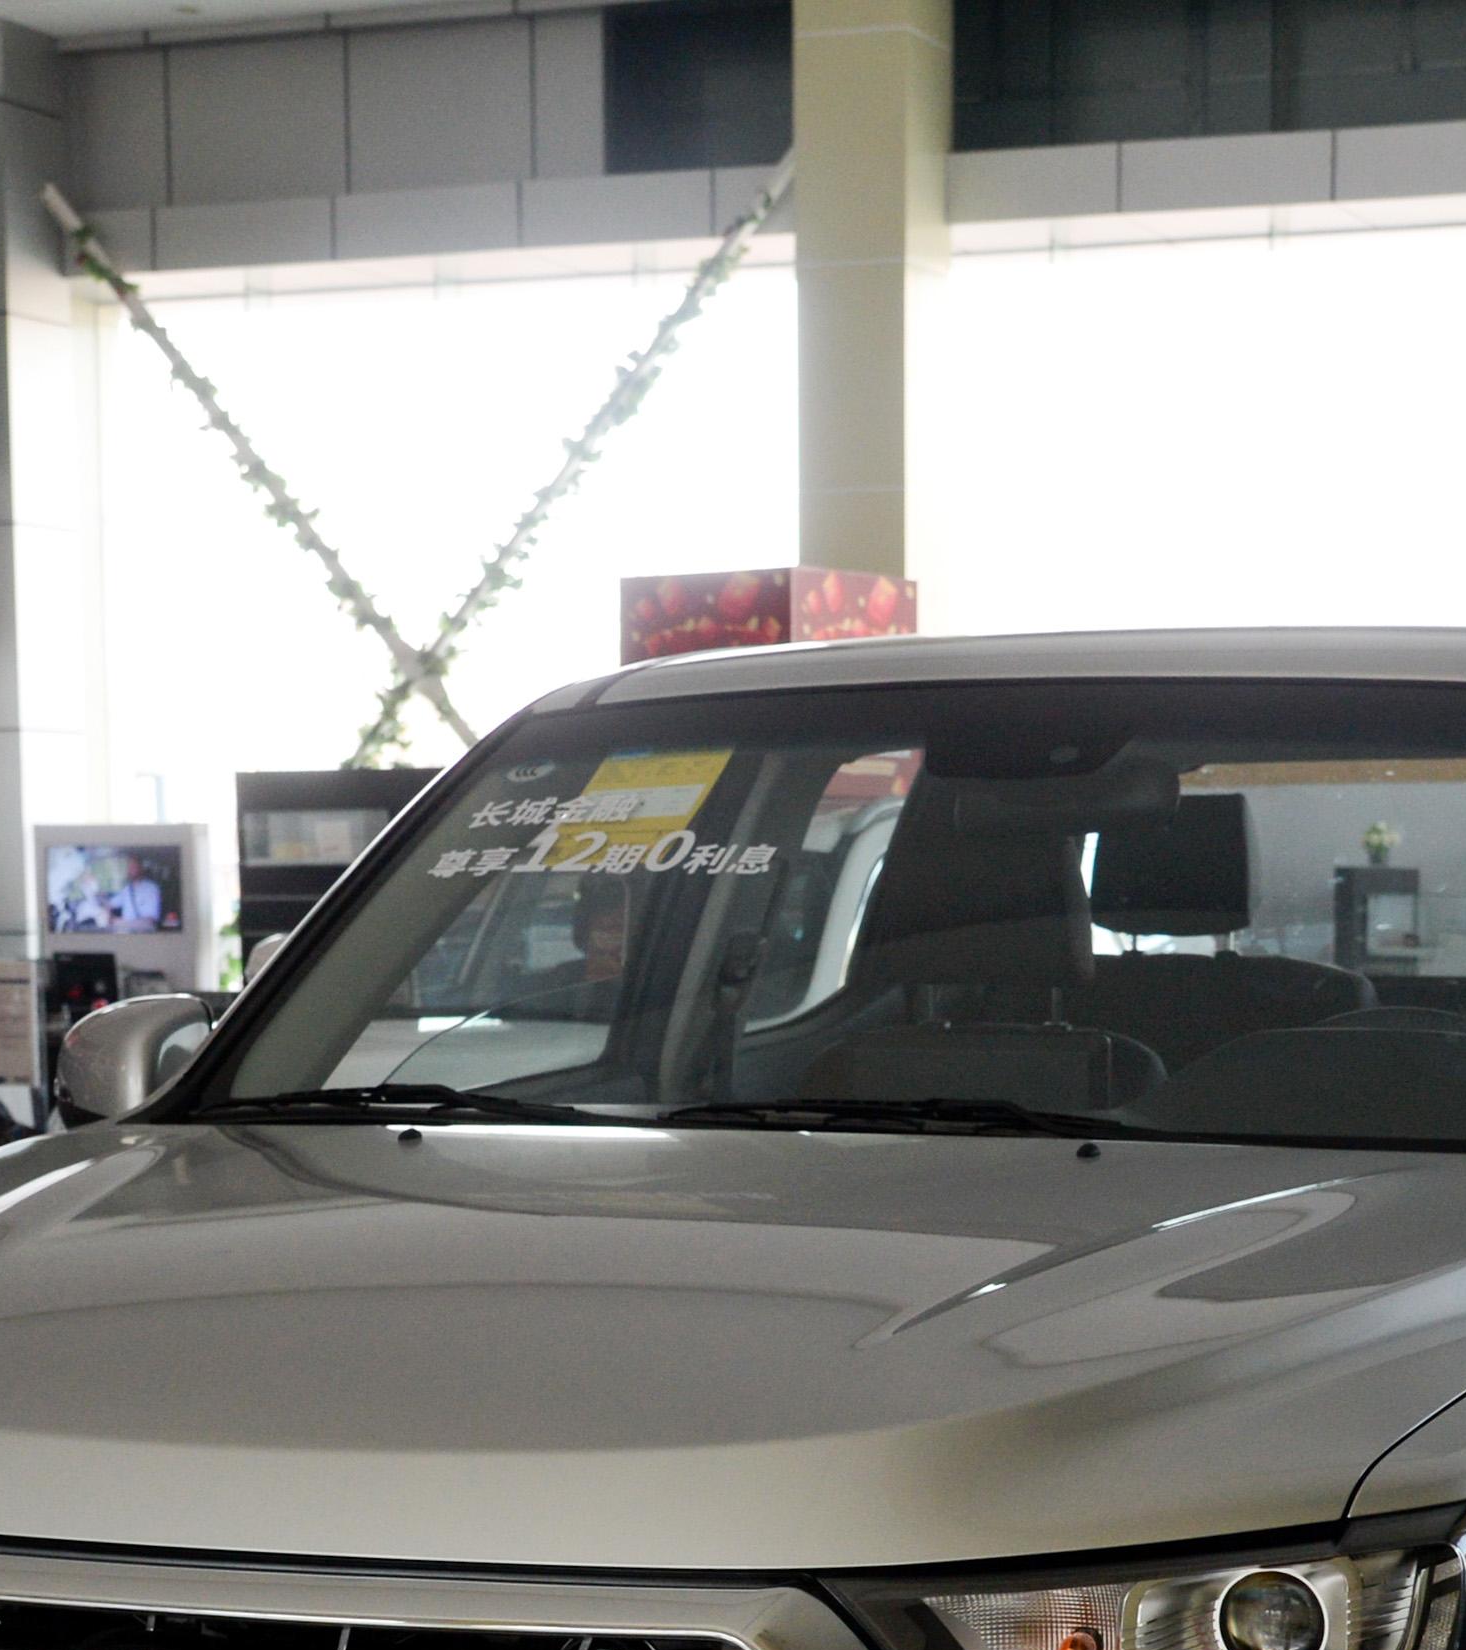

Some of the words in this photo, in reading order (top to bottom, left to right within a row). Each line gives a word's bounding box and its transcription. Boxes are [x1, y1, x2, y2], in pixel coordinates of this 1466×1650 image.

[468, 796, 641, 830] 长城金融
[428, 829, 778, 878] 尊享12期0利息
